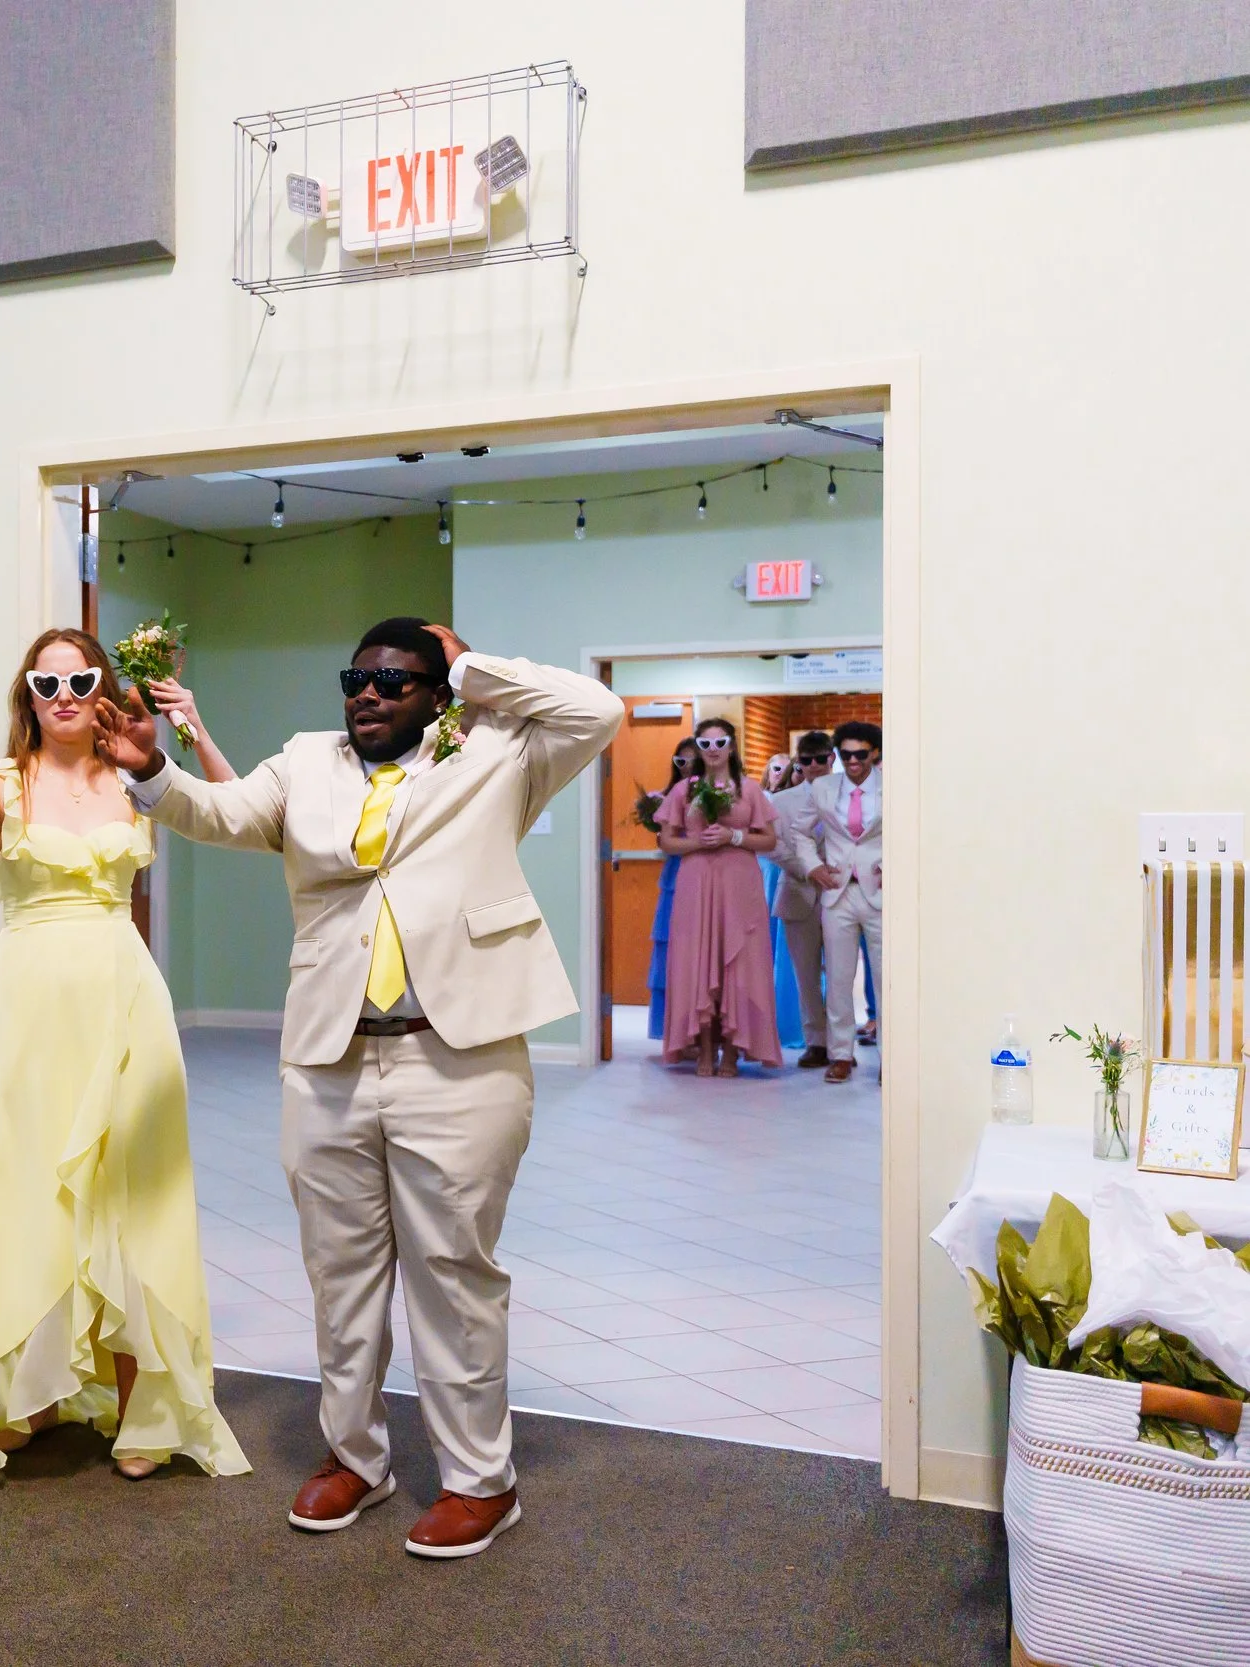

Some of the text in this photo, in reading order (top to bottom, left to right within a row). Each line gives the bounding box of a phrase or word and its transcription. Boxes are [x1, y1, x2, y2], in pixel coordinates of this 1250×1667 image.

[367, 145, 464, 233] EXIT
[757, 561, 803, 597] EXIT
[1172, 1085, 1215, 1097] Cards
[1186, 1104, 1197, 1114] &
[1171, 1121, 1210, 1133] Gifts
